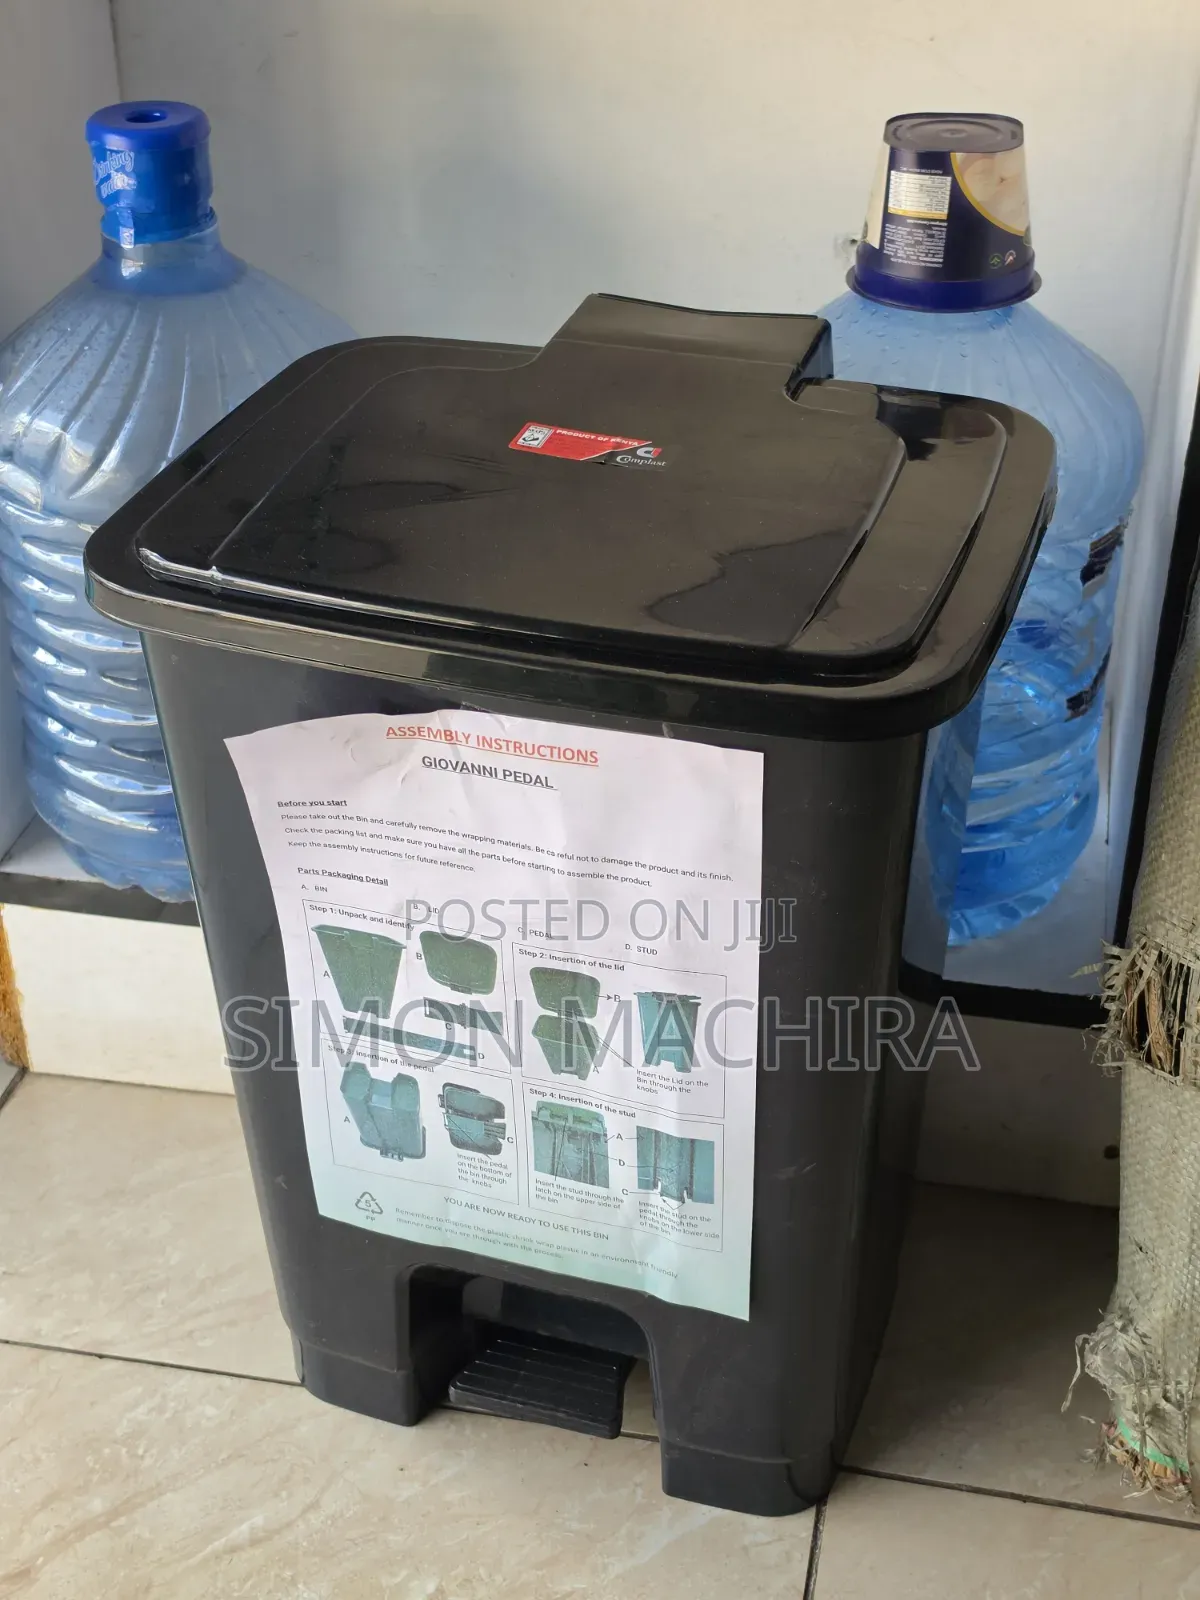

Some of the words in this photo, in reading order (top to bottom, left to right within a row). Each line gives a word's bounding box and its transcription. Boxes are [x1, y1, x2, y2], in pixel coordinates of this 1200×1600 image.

[556, 429, 595, 440] PRODUCT
[616, 455, 667, 467] Complast
[386, 726, 471, 745] ASSEMBLY
[476, 735, 599, 764] INSTRUCTIONS
[421, 756, 498, 779] GIOVANNI
[503, 769, 554, 789] PEDAL
[277, 800, 307, 808] Before
[327, 799, 347, 807] start
[323, 842, 359, 852] assembly
[360, 846, 403, 858] instructions
[404, 852, 416, 860] for
[417, 855, 438, 865] future
[440, 860, 476, 872] reference.
[325, 828, 354, 837] packing
[407, 838, 423, 846] sure
[424, 841, 437, 849] you
[439, 843, 456, 852] have
[457, 847, 467, 855] all
[468, 849, 480, 857] the
[481, 851, 501, 861] parts
[502, 855, 526, 867] before
[527, 861, 556, 874] starting
[557, 868, 565, 876] to
[566, 870, 605, 879] assemble
[606, 873, 619, 881] the
[621, 875, 652, 887] product.
[386, 820, 417, 830] carefully
[419, 825, 447, 834] remove
[462, 832, 495, 844] wrapping
[497, 839, 533, 851] materials.
[535, 845, 545, 853] Be
[576, 855, 589, 863] not
[601, 856, 633, 867] damage
[634, 861, 647, 869] the
[649, 864, 679, 875] product
[681, 869, 695, 878] and
[697, 871, 707, 879] its
[709, 872, 734, 882] finish.
[297, 867, 320, 876] Parts
[321, 869, 364, 883] Packaging
[365, 875, 389, 886] Detail
[315, 885, 328, 893] BIN
[309, 904, 327, 914] Step
[338, 908, 368, 921] Unpack
[369, 915, 384, 923] and
[529, 929, 554, 939] PEDAL
[416, 952, 423, 960] B
[625, 943, 632, 951] D.
[637, 946, 658, 956] STUD
[518, 949, 537, 958] Step
[549, 954, 586, 966] Insertion
[613, 994, 621, 1002] B
[445, 1022, 452, 1031] C
[592, 1066, 600, 1074] A
[637, 1068, 656, 1079] Insert
[658, 1074, 670, 1082] the
[672, 1077, 683, 1085] Lid
[637, 1076, 647, 1084] Bin
[649, 1079, 677, 1092] through
[637, 1084, 659, 1094] knobs
[529, 1088, 547, 1097] Step
[558, 1093, 593, 1107] Insertion
[604, 1105, 617, 1113] the
[618, 1109, 636, 1118] stud
[344, 1115, 351, 1123] A
[507, 1136, 514, 1144] C
[616, 1133, 623, 1141] A
[535, 1178, 555, 1188] Insert
[568, 1187, 584, 1195] stud
[585, 1190, 612, 1202] through
[613, 1196, 624, 1204] the
[535, 1185, 552, 1195] latch
[576, 1197, 595, 1205] upper
[622, 1188, 629, 1196] C
[443, 1196, 462, 1206] YOU
[464, 1202, 481, 1211] ARE
[482, 1206, 506, 1217] NOW
[507, 1212, 537, 1225] READY
[538, 1219, 551, 1228] TO
[552, 1223, 569, 1232] USE
[571, 1226, 591, 1237] THIS
[593, 1231, 609, 1240] BIN
